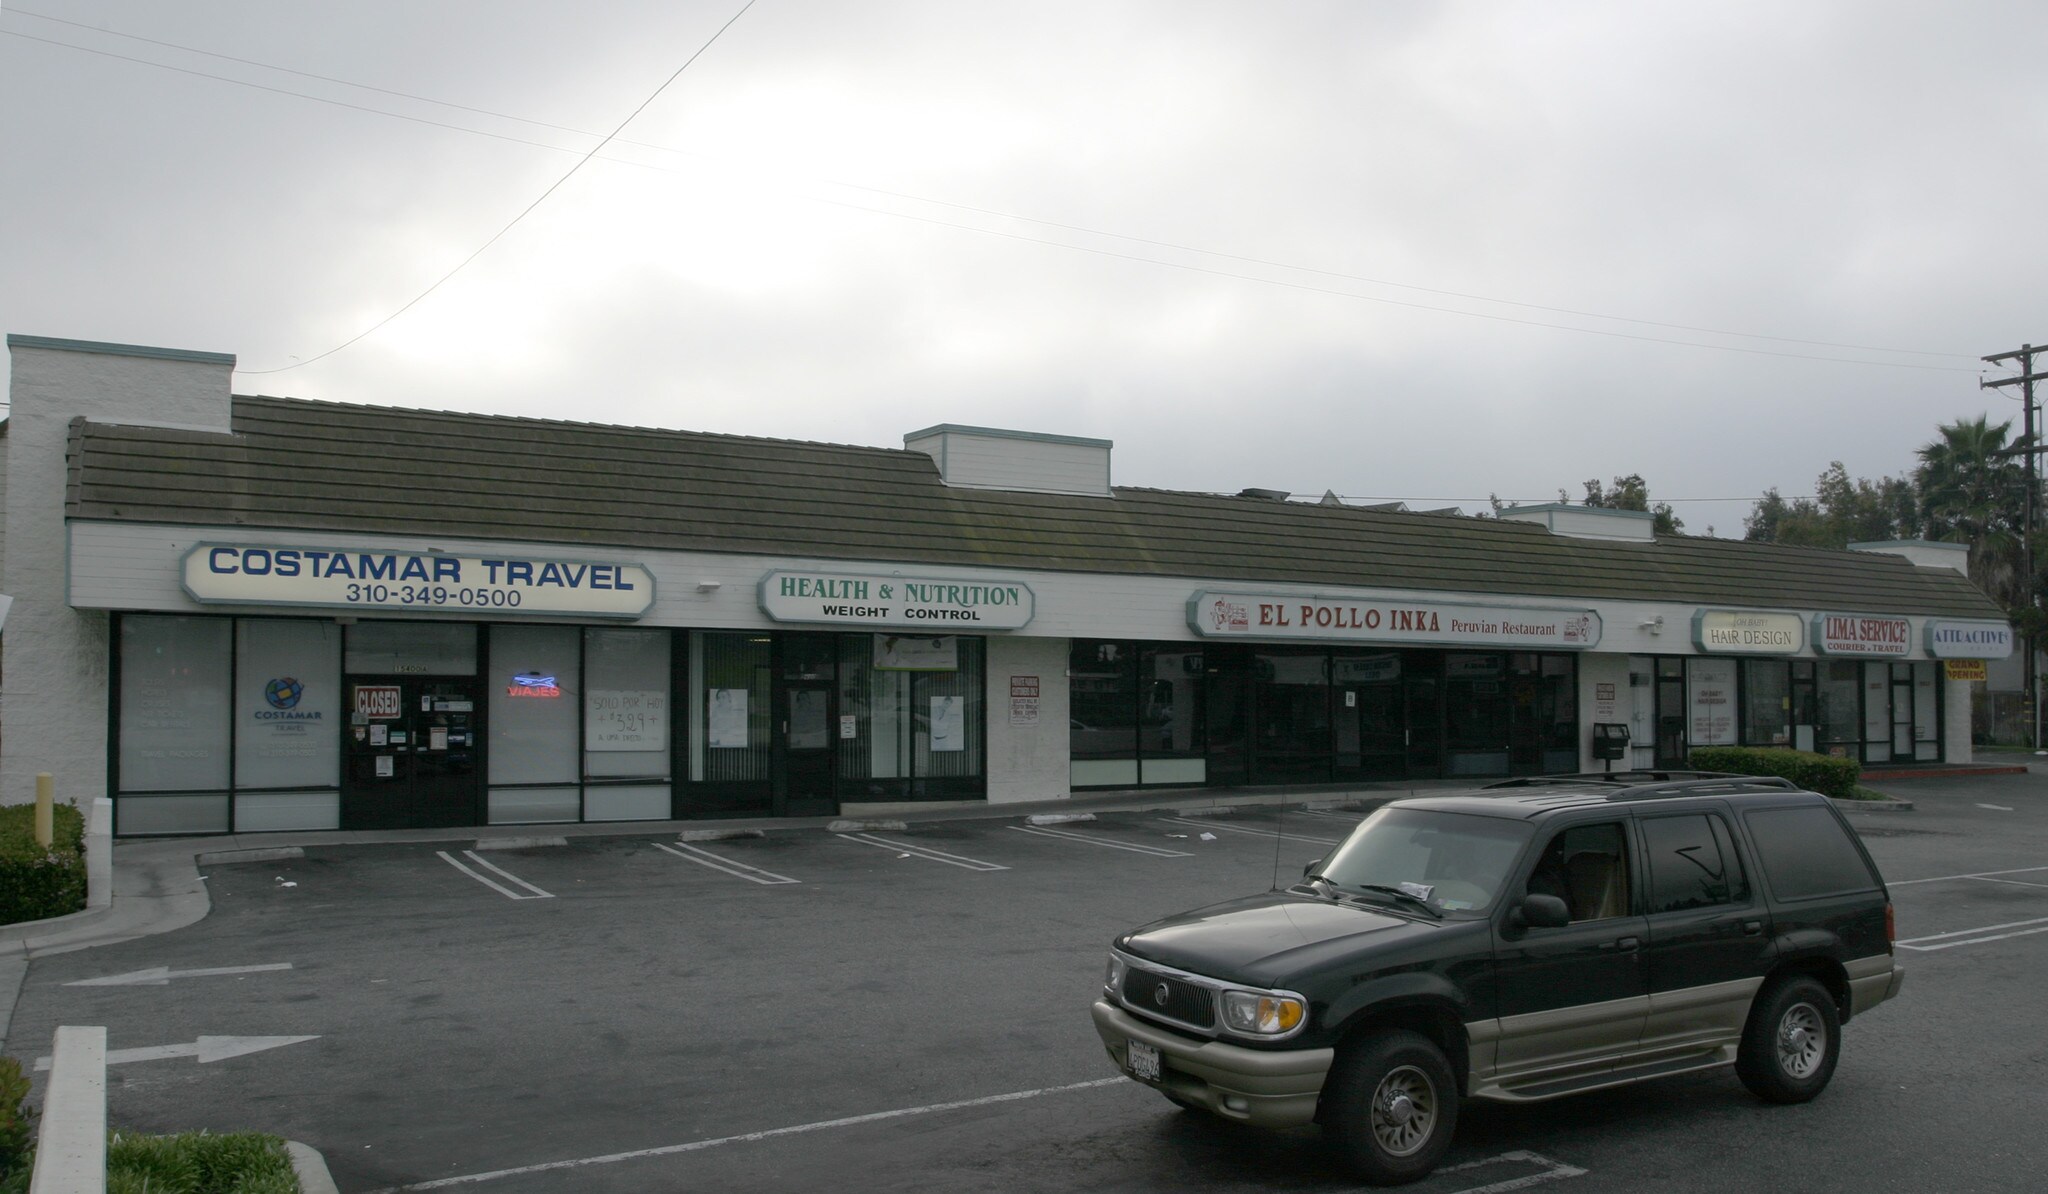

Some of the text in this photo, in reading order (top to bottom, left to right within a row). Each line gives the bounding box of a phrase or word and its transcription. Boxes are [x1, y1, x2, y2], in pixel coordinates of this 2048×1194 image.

[209, 547, 634, 591] COSTAMAR TRAVEL
[347, 583, 521, 607] 310-349-0500
[780, 576, 1019, 607] HEALTH & NUTRITION
[823, 605, 980, 620] WEIGHT CONTROL
[1259, 604, 1556, 635] EL POLLO INKA Peruvian Restaurant
[1711, 629, 1791, 645] HAIR DESIGN
[1826, 617, 1906, 643] LIMA SERVICE
[1828, 642, 1904, 653] COURIER TRAVEL
[1949, 660, 1980, 669] GRAND
[508, 686, 560, 698] VIAJES
[358, 690, 398, 714] CLOSED
[593, 697, 664, 711] SOLO POR HOY
[254, 711, 322, 720] COSTAMAR
[276, 724, 304, 732] TRAVEL
